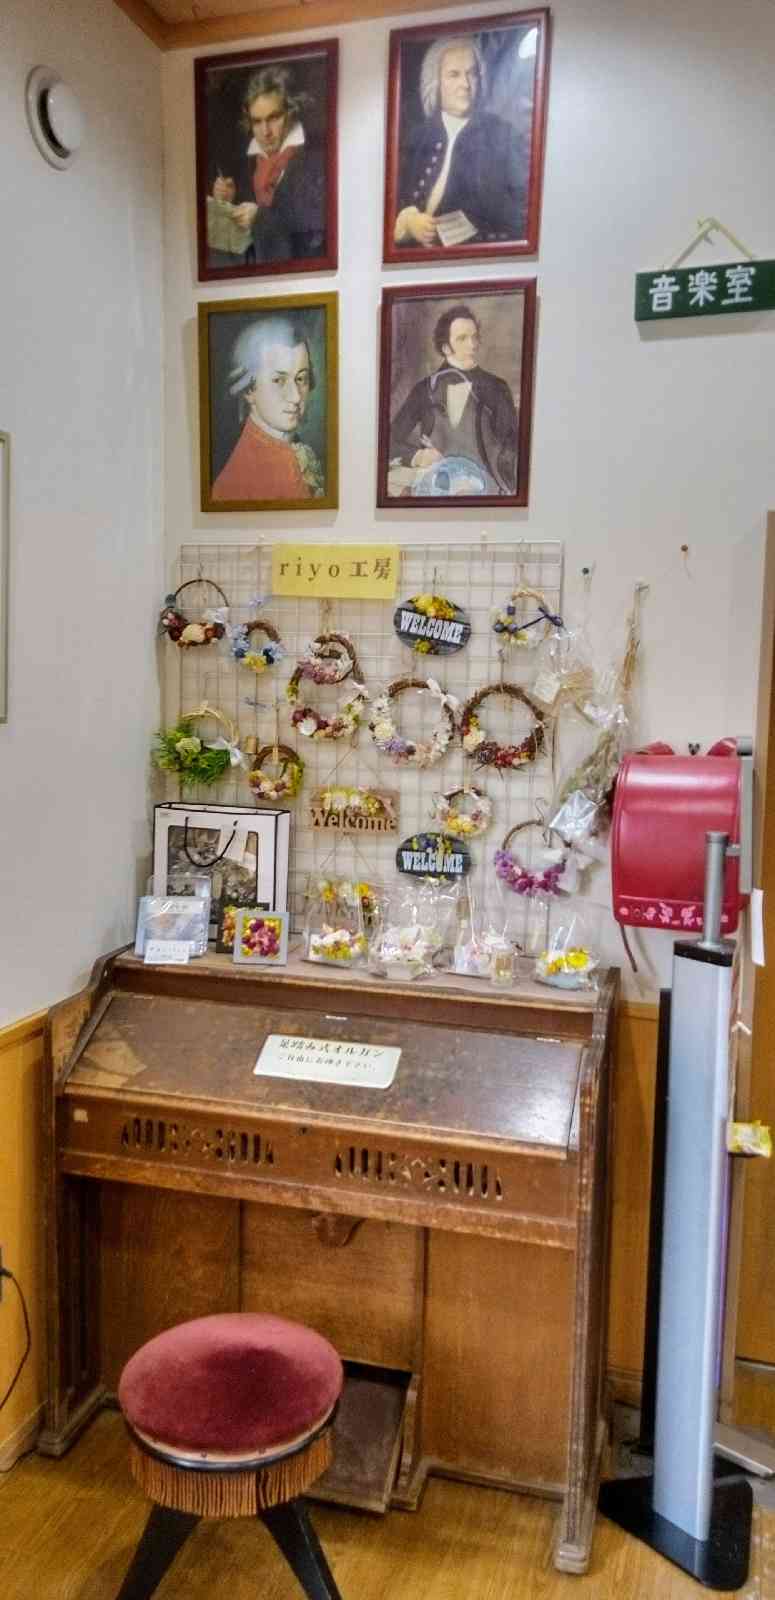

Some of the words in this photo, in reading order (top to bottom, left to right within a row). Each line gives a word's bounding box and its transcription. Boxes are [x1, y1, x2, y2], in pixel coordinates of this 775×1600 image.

[649, 265, 756, 312] 音楽室
[350, 557, 392, 580] 工房
[401, 610, 465, 644] WELCOME
[310, 807, 398, 832] Welcome
